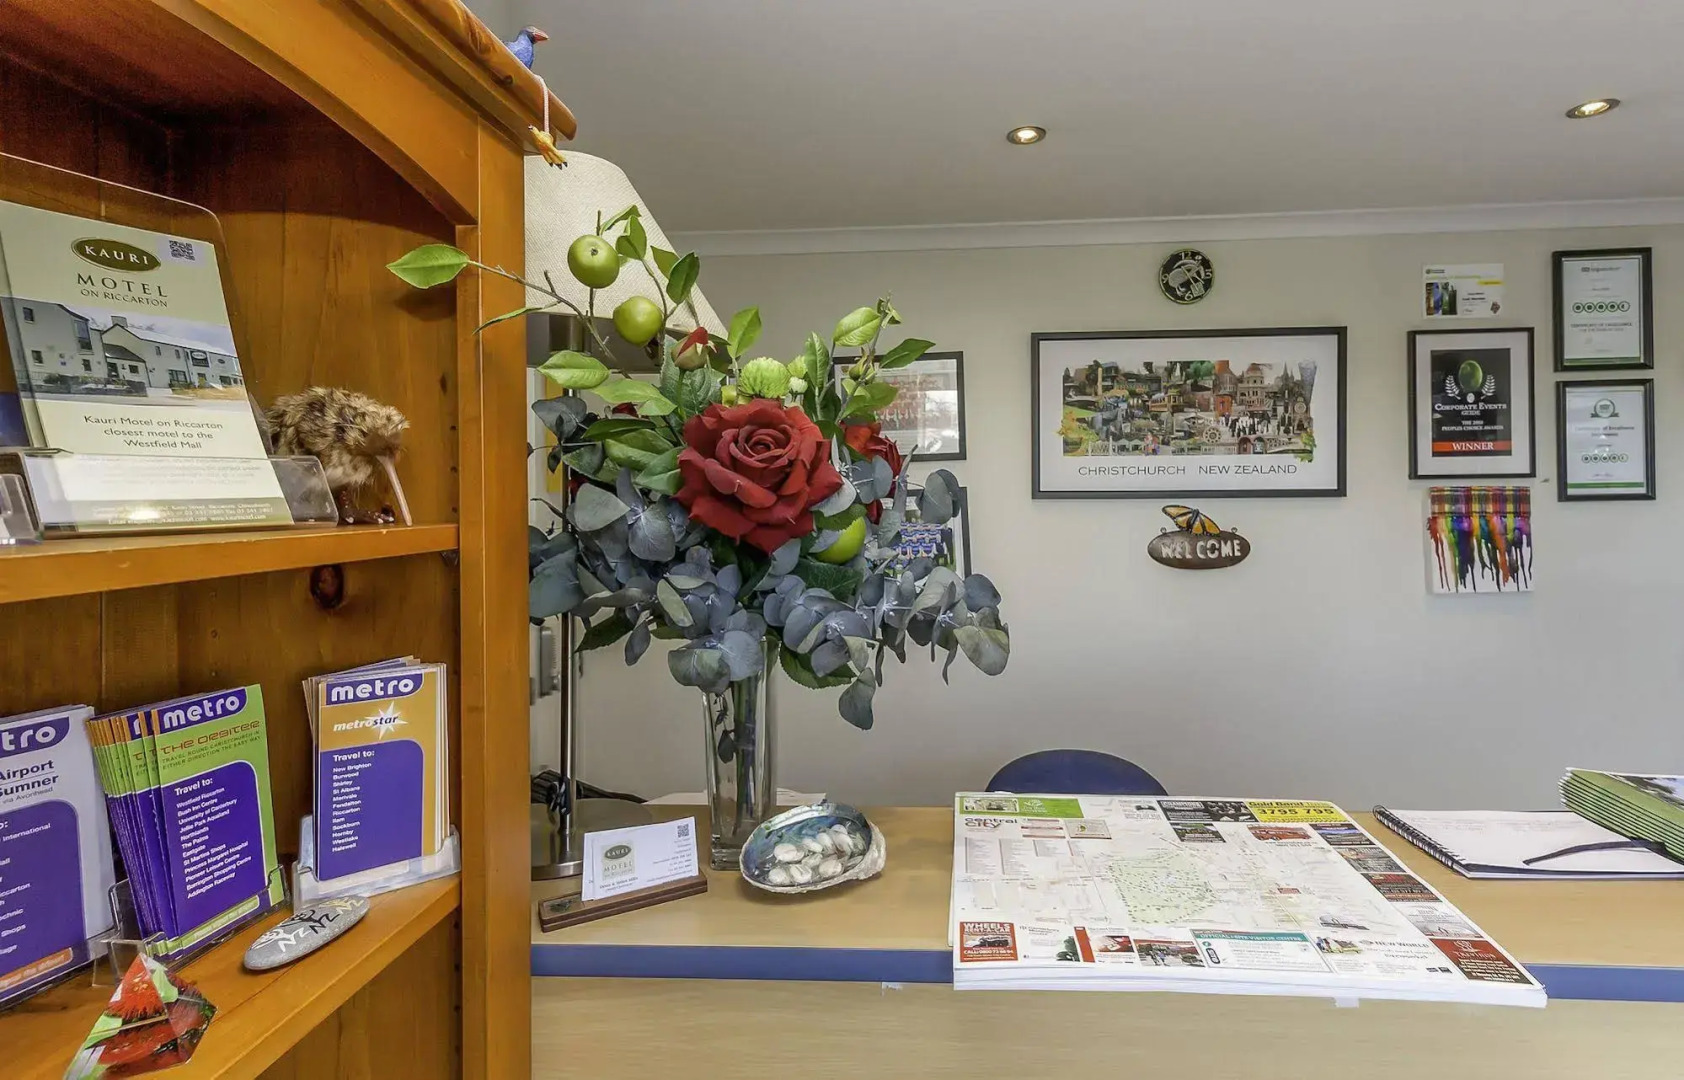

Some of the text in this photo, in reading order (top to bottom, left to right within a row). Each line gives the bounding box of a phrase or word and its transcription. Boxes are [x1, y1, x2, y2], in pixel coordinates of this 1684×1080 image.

[84, 245, 149, 265] KAURI
[77, 273, 167, 297] MOTEL
[80, 288, 168, 308] ON RICCARTON
[1184, 290, 1194, 301] 6
[84, 415, 117, 425] Kauri
[120, 417, 153, 426] Motel
[174, 419, 223, 429] Riccarton
[104, 428, 144, 436] closest
[147, 430, 179, 438] motel
[124, 439, 202, 449] Westfield Mall
[1452, 442, 1494, 451] WINNER
[1078, 464, 1297, 476] CHRISTCHURCH NEW ZEALAND
[1161, 539, 1242, 559] WELCOME
[331, 678, 414, 702] metro
[163, 695, 240, 729] metro
[333, 715, 399, 732] metrostar
[1, 726, 56, 751] tro
[160, 720, 260, 755] THE ORBITER
[162, 752, 186, 763] TRAVEL
[187, 746, 209, 757] ROUND
[162, 758, 187, 770] EITHER
[187, 749, 220, 764] DIRECTION
[333, 750, 375, 763] Travel to:
[347, 762, 372, 772] Brighton
[333, 771, 359, 780] Burwood
[174, 778, 213, 796] Travel to:
[333, 780, 353, 788] Shirley
[16, 786, 53, 803] Avonhead
[333, 793, 357, 802] Merivale
[177, 808, 192, 817] Bush
[178, 811, 204, 825] University
[333, 806, 361, 816] Riccarton
[194, 819, 206, 827] Park
[2, 823, 51, 842] International
[333, 829, 354, 838] Hornby
[332, 835, 359, 845] Westlake
